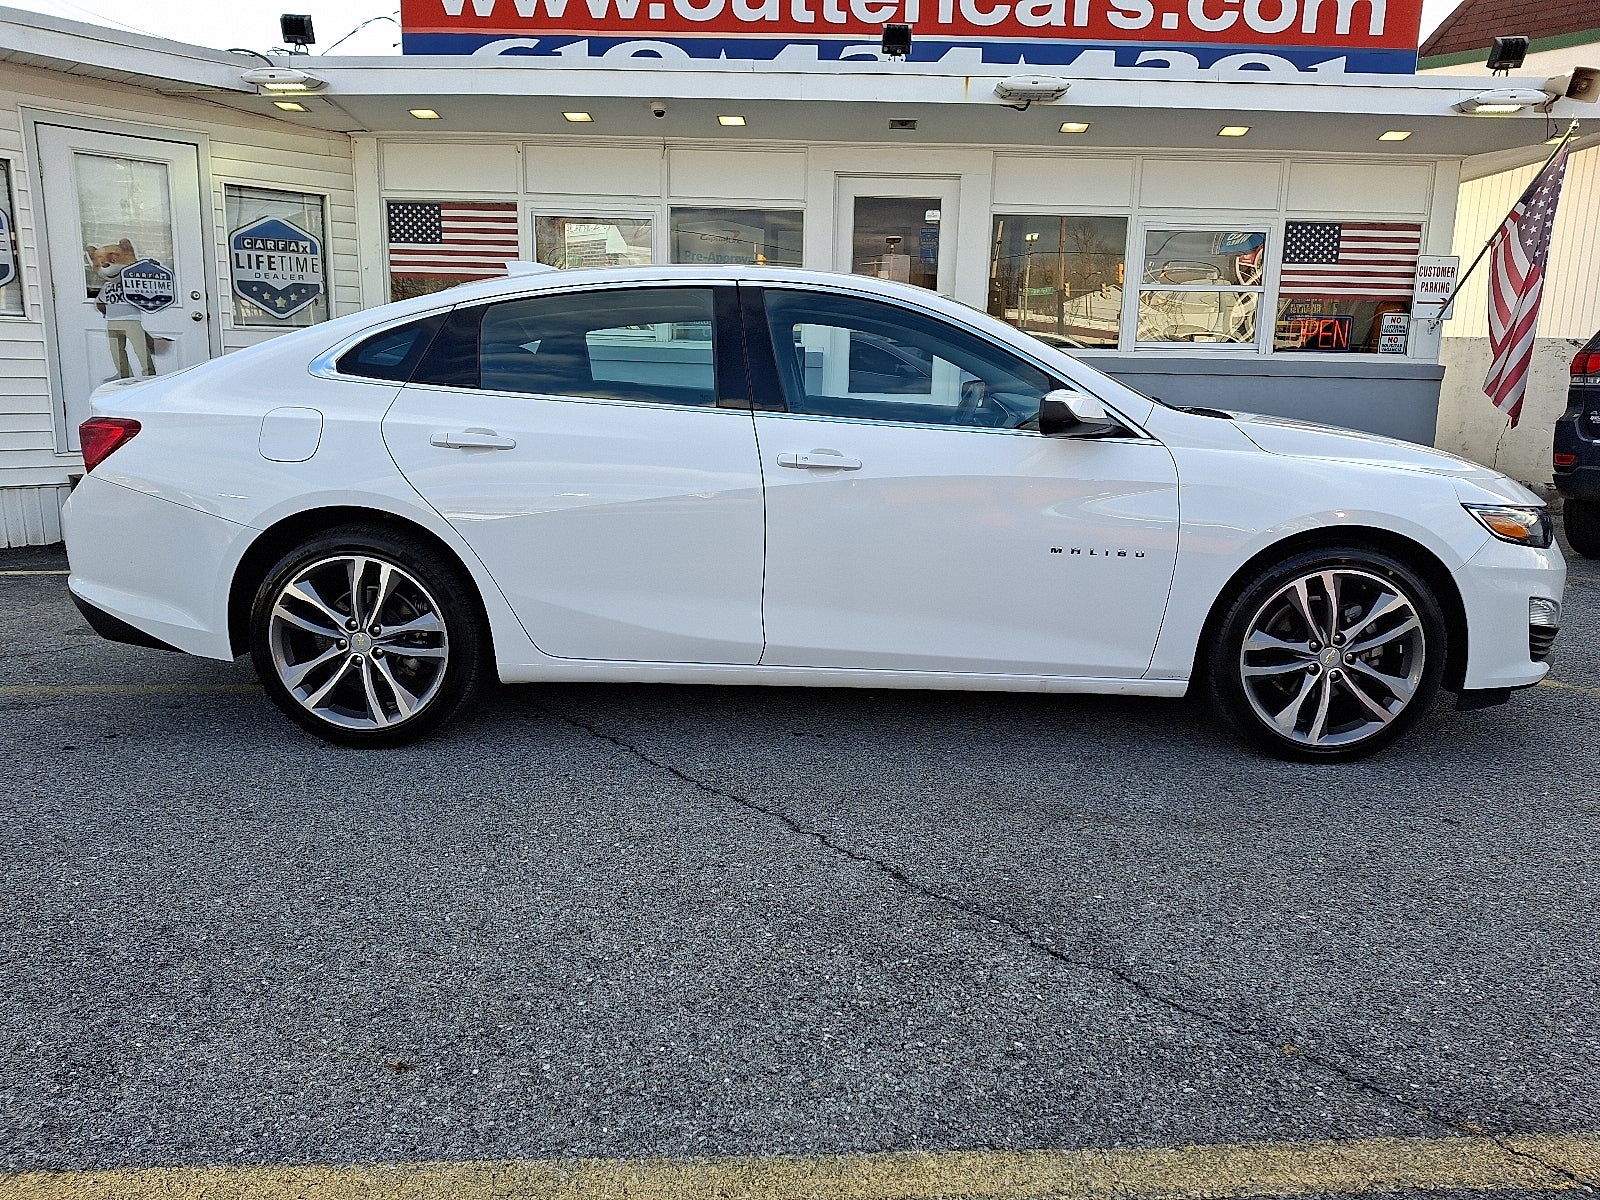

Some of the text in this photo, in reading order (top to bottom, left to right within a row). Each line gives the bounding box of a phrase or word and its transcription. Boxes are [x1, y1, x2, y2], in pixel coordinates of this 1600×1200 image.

[242, 237, 310, 253] CARFAX
[234, 252, 319, 273] LIFETIME
[128, 271, 167, 280] CARFAX
[254, 272, 305, 281] DEALER
[1419, 265, 1456, 278] CUSTOMER
[124, 280, 172, 291] LIFETIME
[1420, 281, 1451, 293] PARKING
[105, 293, 124, 304] FOX
[1390, 316, 1402, 324] NO
[1287, 318, 1349, 349] OPEN
[1387, 336, 1399, 344] NO
[1050, 546, 1145, 558] MALIBU
